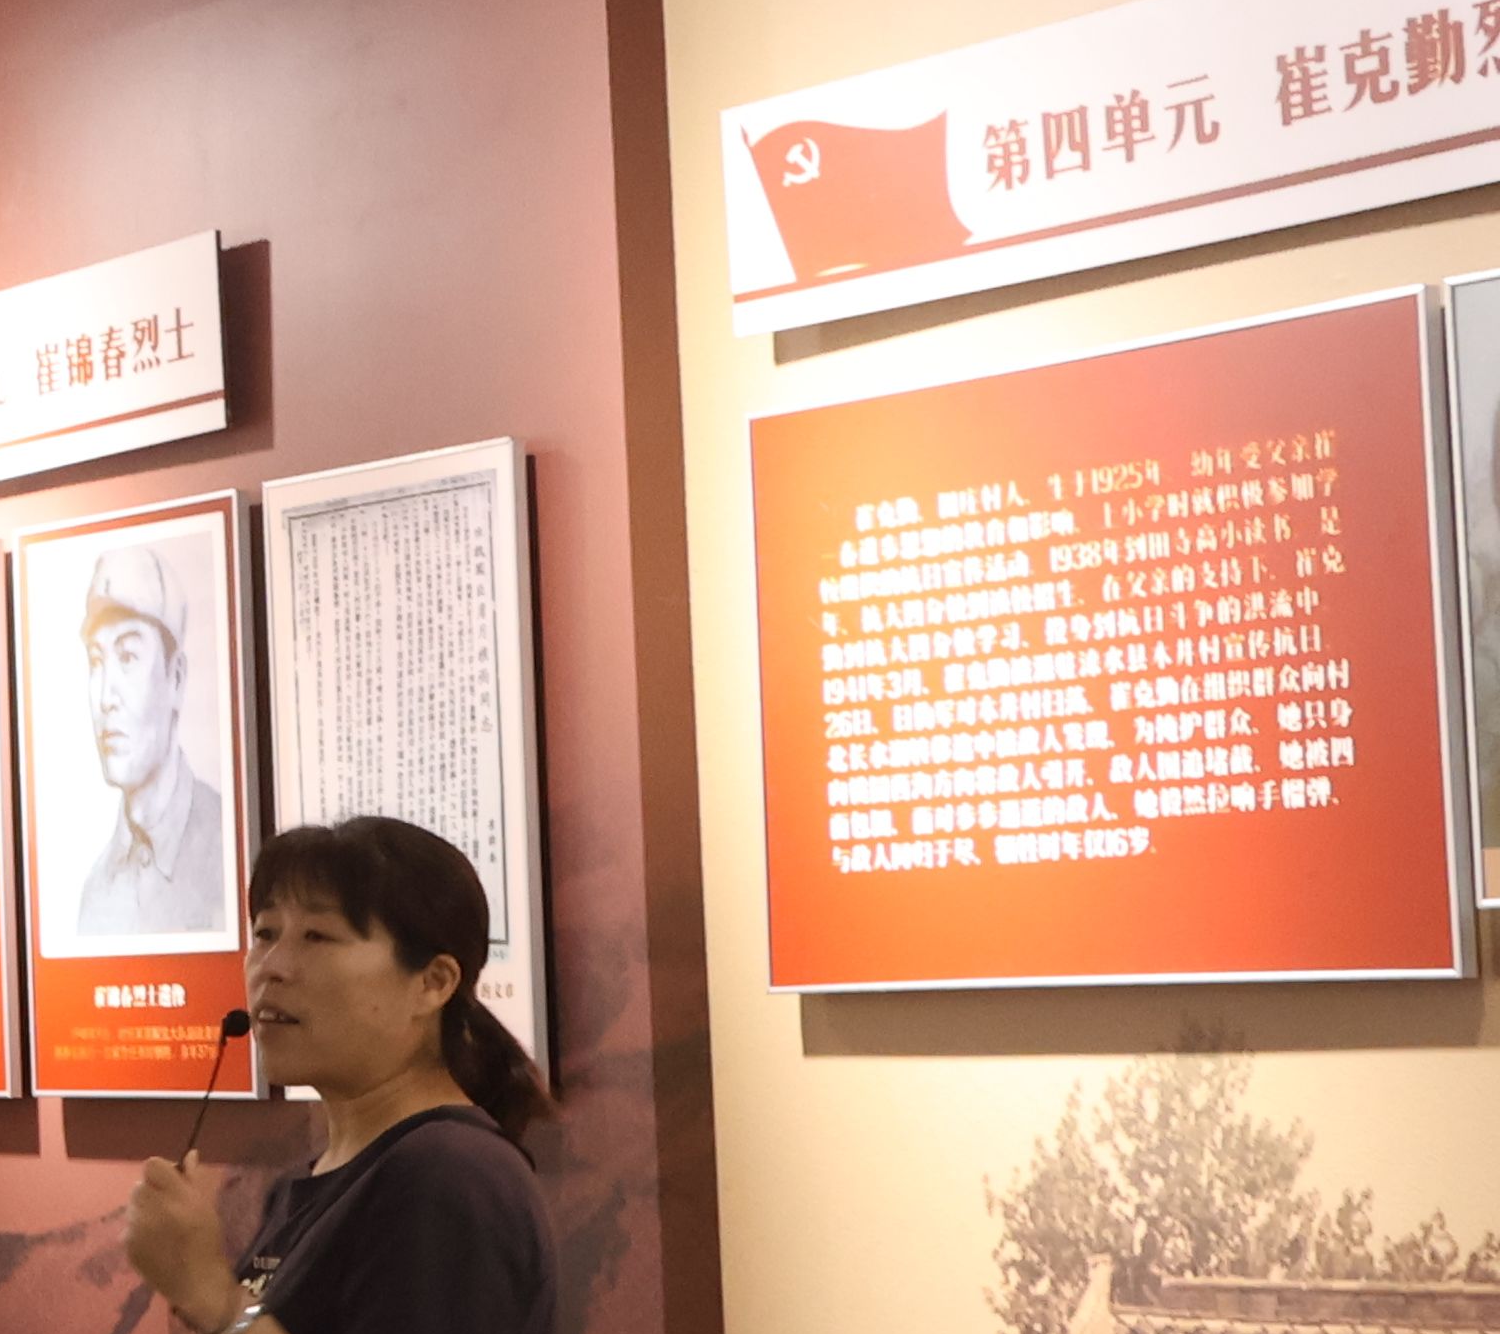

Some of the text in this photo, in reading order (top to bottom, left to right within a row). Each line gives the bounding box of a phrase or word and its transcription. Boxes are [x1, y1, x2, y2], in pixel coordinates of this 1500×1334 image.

[982, 73, 1221, 191] 第四单元
[35, 305, 196, 397] 崔锦春烈士
